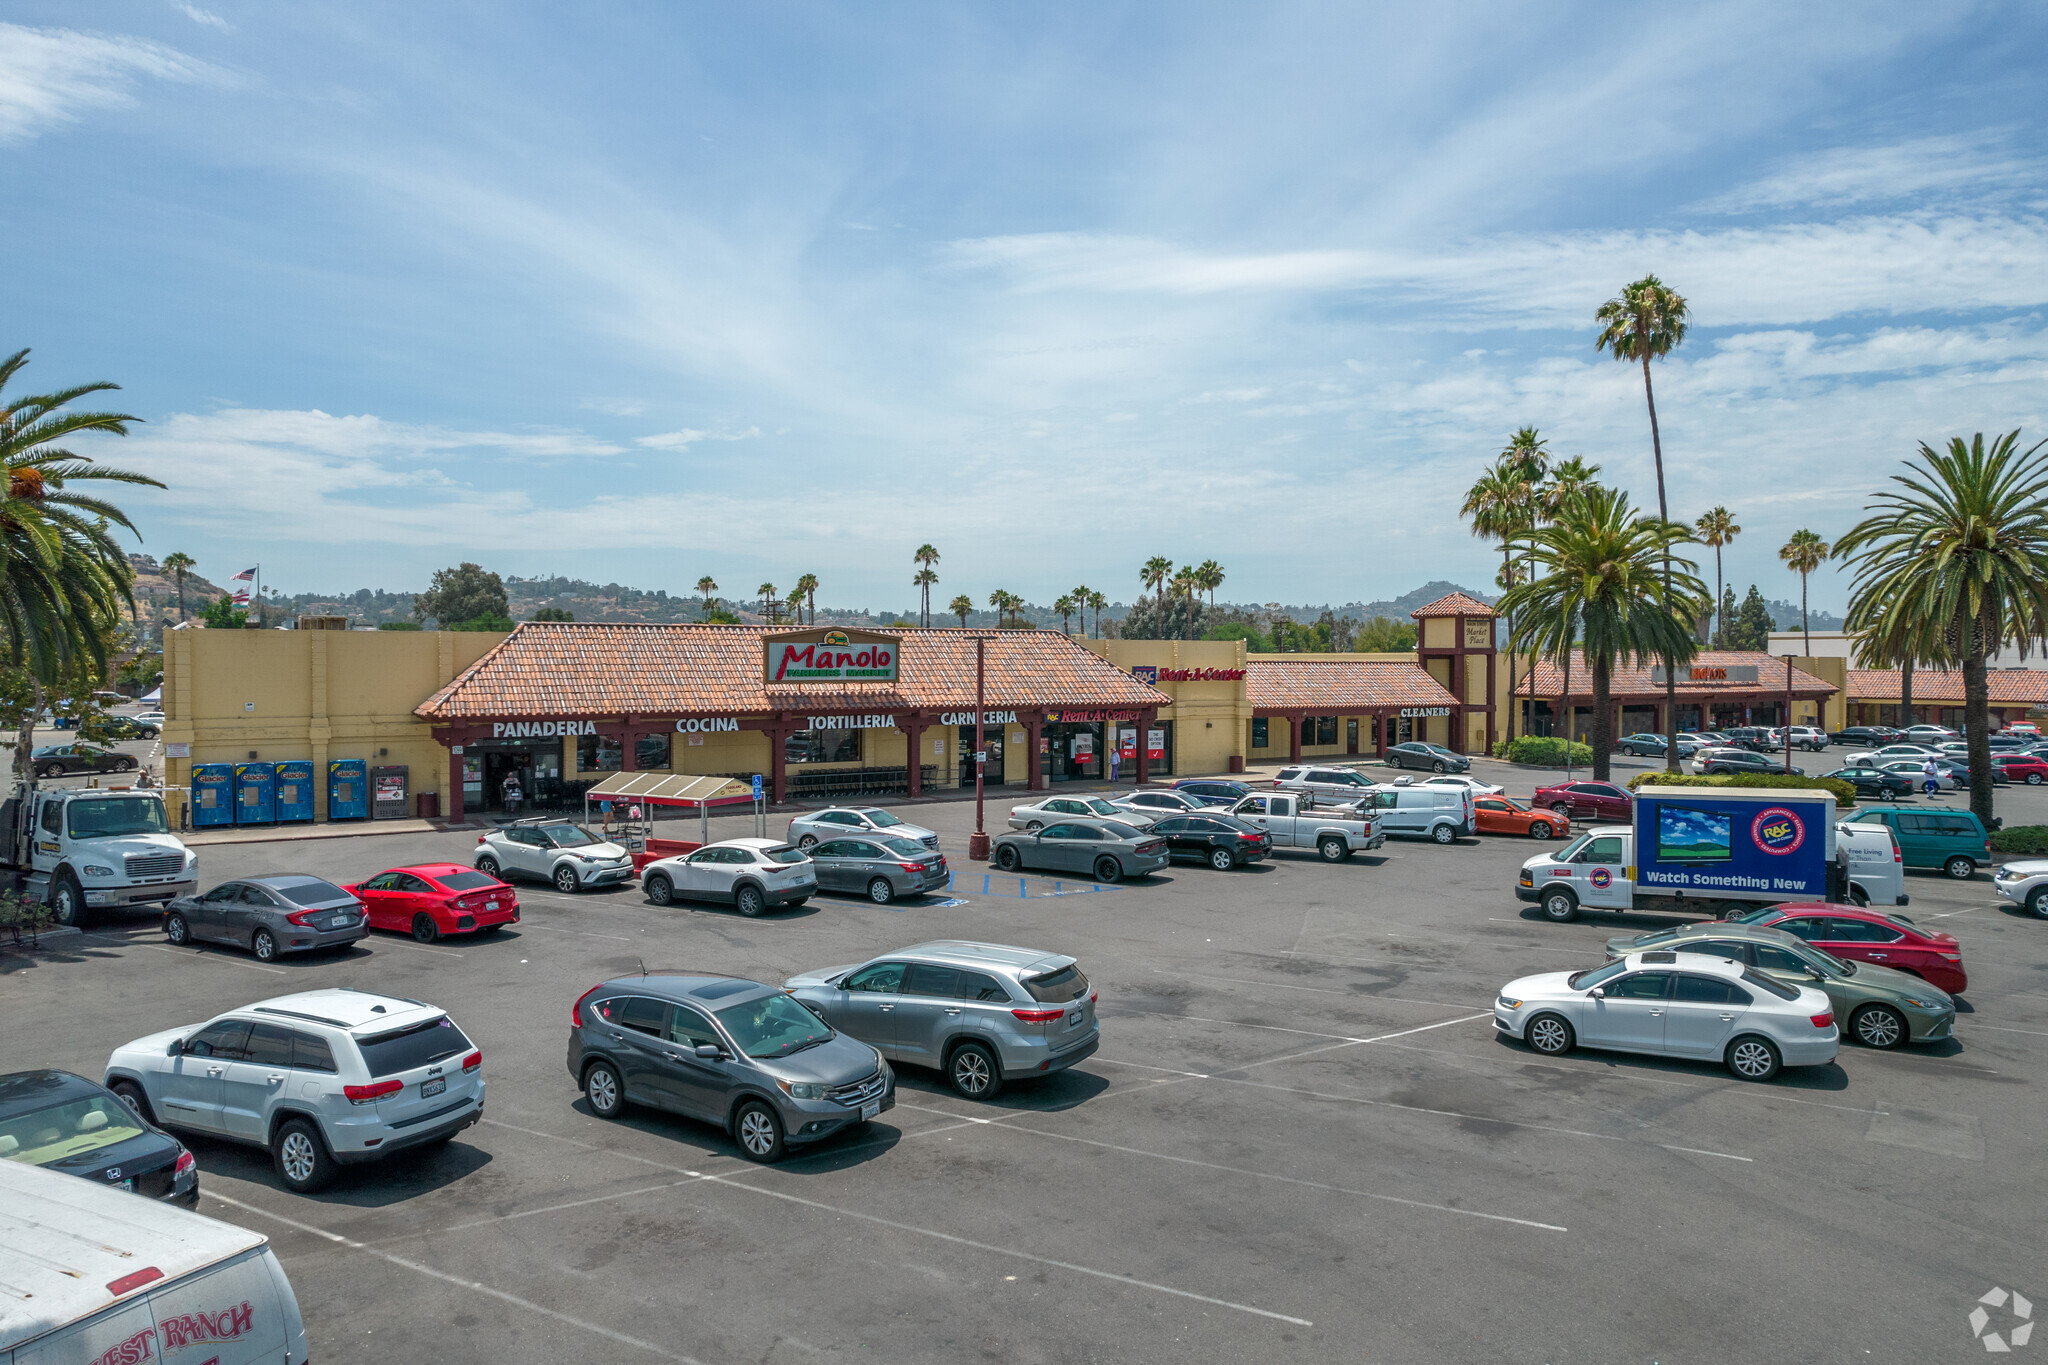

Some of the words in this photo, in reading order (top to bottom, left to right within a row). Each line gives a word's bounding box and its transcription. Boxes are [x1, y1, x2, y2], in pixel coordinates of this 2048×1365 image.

[1466, 627, 1488, 637] Market
[1469, 636, 1485, 645] Place
[775, 644, 891, 681] Manolo
[787, 669, 841, 677] FARMERS
[846, 669, 892, 677] MARKET
[1047, 713, 1059, 722] RAC
[1400, 707, 1450, 718] CLEANERS
[807, 714, 896, 730] TORTILLERIA
[940, 710, 1018, 726] CARNCERIA
[493, 720, 597, 738] PANADERIA
[676, 717, 739, 733] COCINA
[197, 775, 227, 783] Glacier
[241, 773, 269, 781] Glacier
[281, 771, 308, 779] Glacier
[1763, 809, 1792, 818] APPLIANCES
[1763, 823, 1791, 838] RAC
[1793, 819, 1803, 847] ELECTRONICS
[1863, 848, 1882, 856] Living
[1646, 871, 1690, 883] Watch
[1693, 874, 1770, 889] Something
[1774, 878, 1806, 890] New
[428, 1066, 443, 1076] Jeep
[158, 1300, 254, 1350] RANCH
